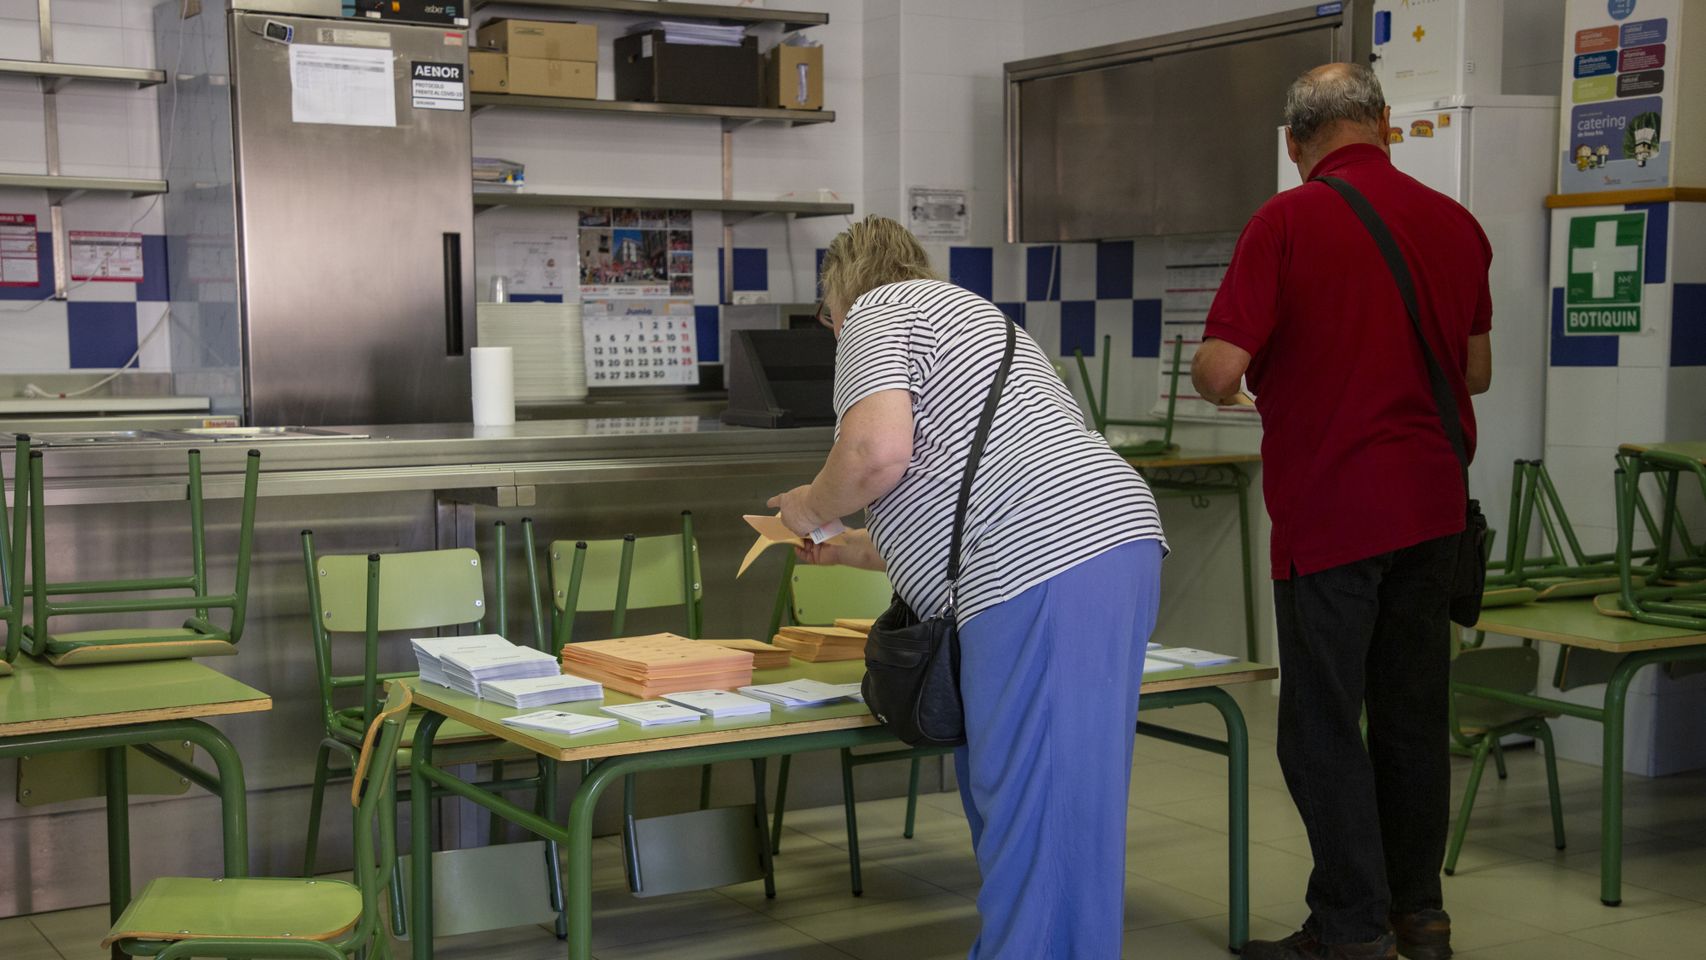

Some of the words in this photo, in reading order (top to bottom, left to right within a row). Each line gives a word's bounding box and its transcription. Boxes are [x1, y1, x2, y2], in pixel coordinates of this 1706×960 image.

[414, 65, 459, 78] AENOR
[1577, 115, 1626, 130] catering
[1570, 311, 1637, 327] BOTIQUIN
[666, 333, 676, 341] 10
[681, 333, 689, 341] 11
[594, 347, 603, 355] 12
[609, 347, 618, 355] 13
[624, 346, 633, 354] 14
[638, 346, 647, 354] 15
[652, 346, 662, 354] 16
[667, 345, 676, 354] 17
[681, 345, 691, 353] 18
[595, 359, 604, 367] 19
[609, 359, 620, 367] 20
[624, 359, 634, 367] 21
[638, 358, 649, 366] 22
[653, 358, 663, 366] 23
[667, 358, 678, 366] 24
[681, 357, 692, 366] 25
[595, 372, 606, 380] 26
[610, 372, 621, 380] 27
[624, 371, 636, 379] 28
[638, 371, 650, 379] 29
